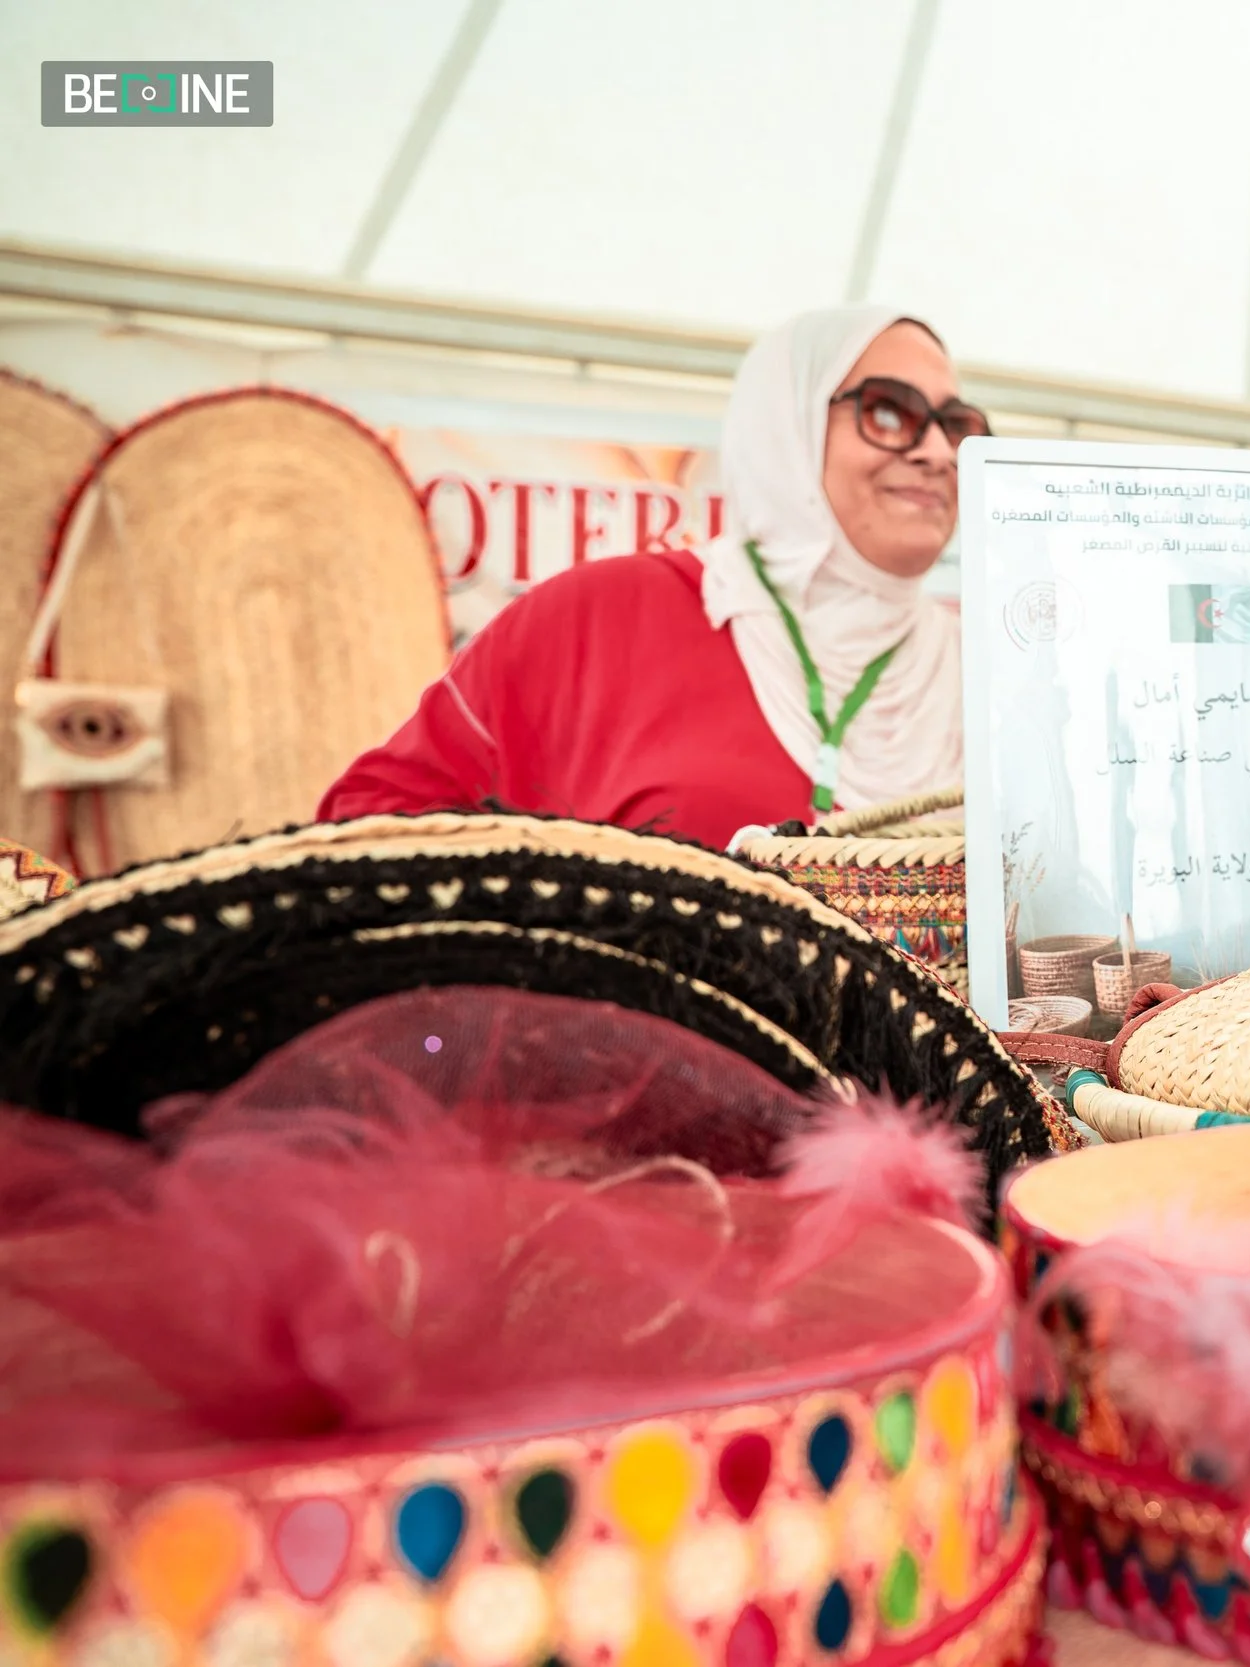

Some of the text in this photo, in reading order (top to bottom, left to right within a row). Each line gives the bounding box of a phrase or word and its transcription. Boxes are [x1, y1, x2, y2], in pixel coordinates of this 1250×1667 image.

[1115, 481, 1211, 500] الديمقراطية
[1081, 537, 1133, 554] المصغر
[1136, 538, 1181, 555] القرض
[1132, 672, 1181, 709] أمال
[1168, 743, 1233, 764] صناعة
[1137, 854, 1201, 887] البويرة
